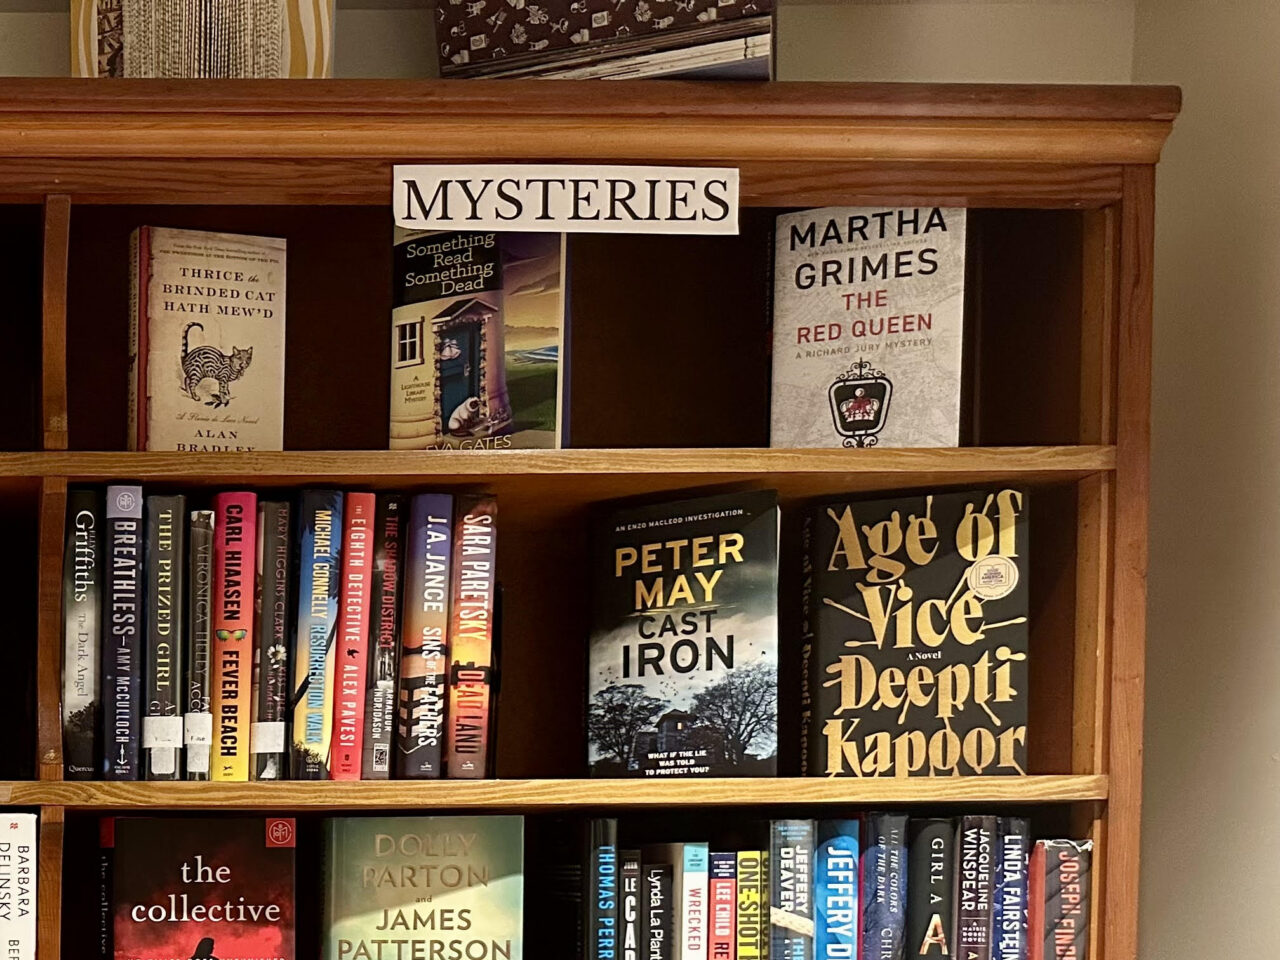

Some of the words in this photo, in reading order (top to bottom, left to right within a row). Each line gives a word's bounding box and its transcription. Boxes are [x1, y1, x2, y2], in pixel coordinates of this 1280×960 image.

[401, 178, 730, 221] MYSTERIES
[790, 208, 947, 251] MARTHA
[407, 233, 495, 259] Something
[433, 248, 473, 268] Read
[179, 267, 243, 282] THRICE
[405, 263, 494, 287] Something
[795, 248, 939, 290] GRIMES
[163, 284, 240, 298] BRINDED
[245, 290, 276, 302] CAT
[440, 277, 484, 295] Dead
[842, 290, 888, 311] THE
[163, 302, 209, 314] HATH
[797, 323, 842, 344] RED
[852, 313, 932, 337] QUEEN
[806, 346, 850, 358] RICHARD
[854, 343, 880, 353] JURY
[885, 338, 932, 349] MYSTERY
[195, 429, 238, 439] ALAN
[459, 435, 512, 451] GATES
[225, 504, 243, 546] CARL
[628, 522, 647, 530] ENZO
[649, 518, 683, 527] MACLEOD
[686, 509, 744, 522] INVESTIGATION
[463, 515, 491, 556] SARA
[827, 504, 939, 583] Age
[956, 490, 1022, 562] of
[615, 533, 744, 577] PETER
[224, 551, 242, 621] HIAASEN
[459, 560, 490, 640] PARETSKY
[635, 570, 723, 610] MAY
[638, 609, 717, 639] CAST
[851, 581, 986, 649] Vice
[622, 635, 734, 679] IRON
[222, 650, 239, 699] FEVER
[829, 647, 1026, 718] Deepti
[221, 705, 238, 757] BEACH
[823, 718, 1026, 778] Kapoor
[374, 833, 477, 857] DOLLY
[17, 845, 29, 917] BARBARA
[181, 855, 231, 883] the
[361, 864, 489, 888] PARTON
[826, 846, 852, 937] JEFFERY
[131, 894, 281, 922] collective
[376, 909, 472, 930] JAMES
[338, 939, 511, 960] PATTERSON
